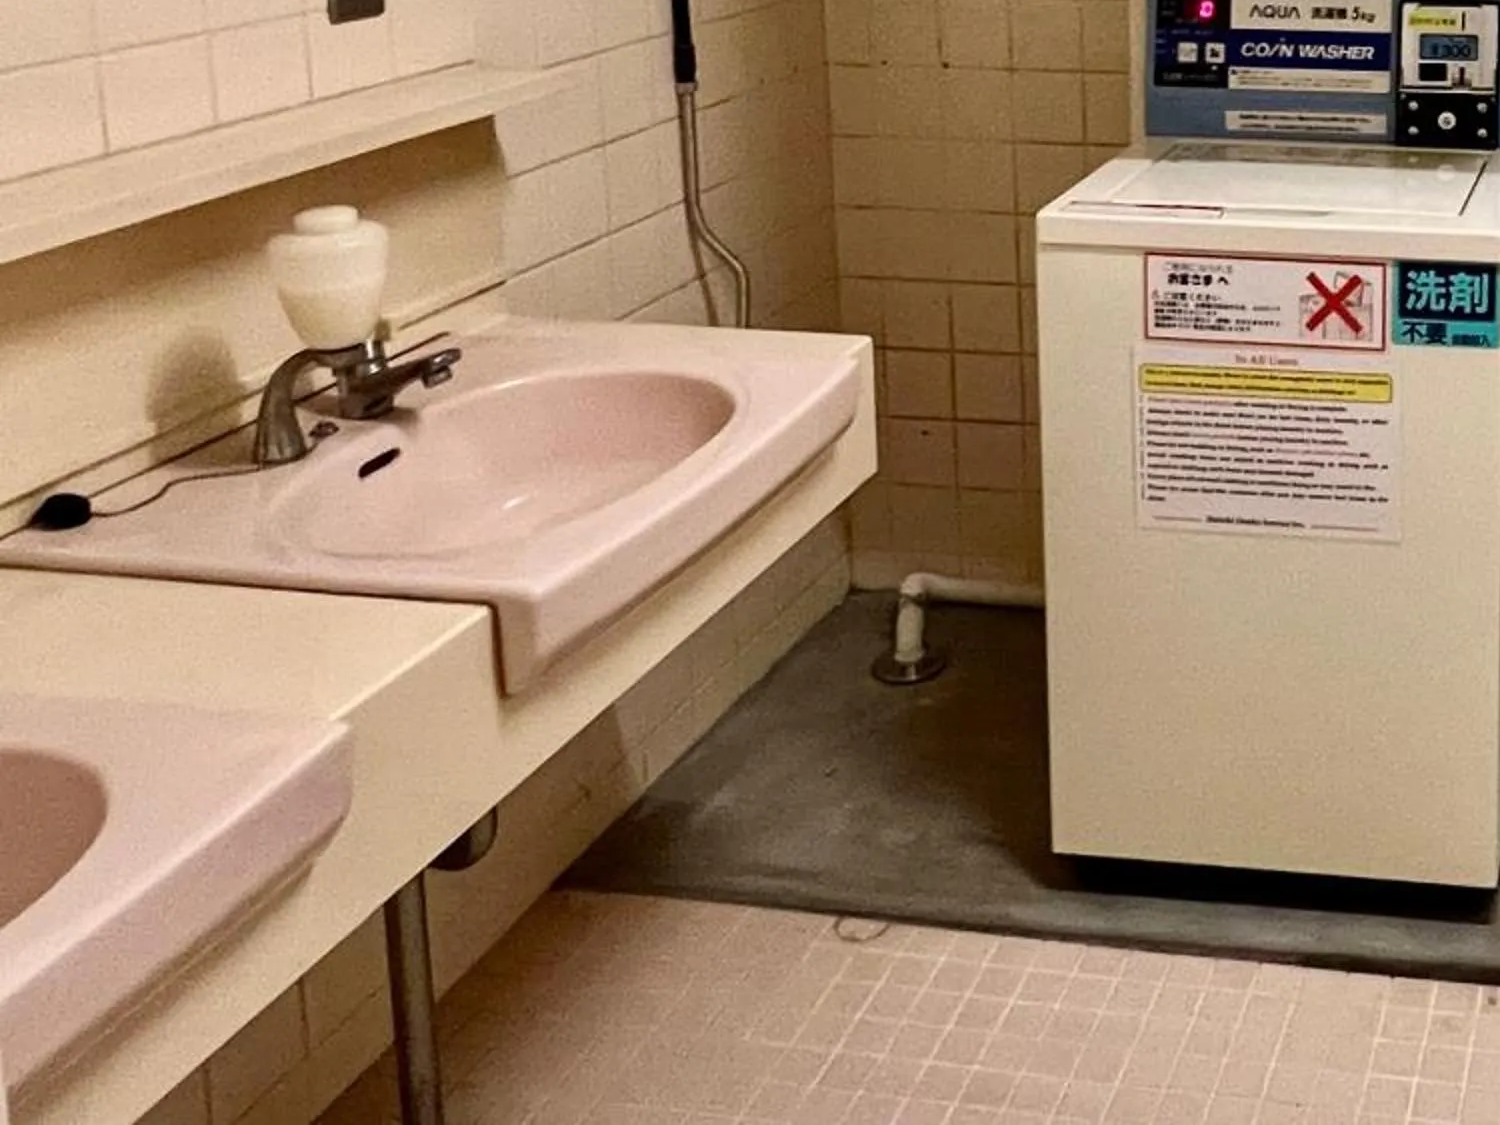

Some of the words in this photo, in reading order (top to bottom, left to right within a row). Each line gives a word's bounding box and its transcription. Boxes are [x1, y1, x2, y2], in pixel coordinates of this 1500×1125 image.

[1248, 3, 1301, 20] AQUA
[1298, 43, 1376, 60] WASHER
[1405, 269, 1490, 314] 洗剤
[1401, 321, 1449, 346] 不要
